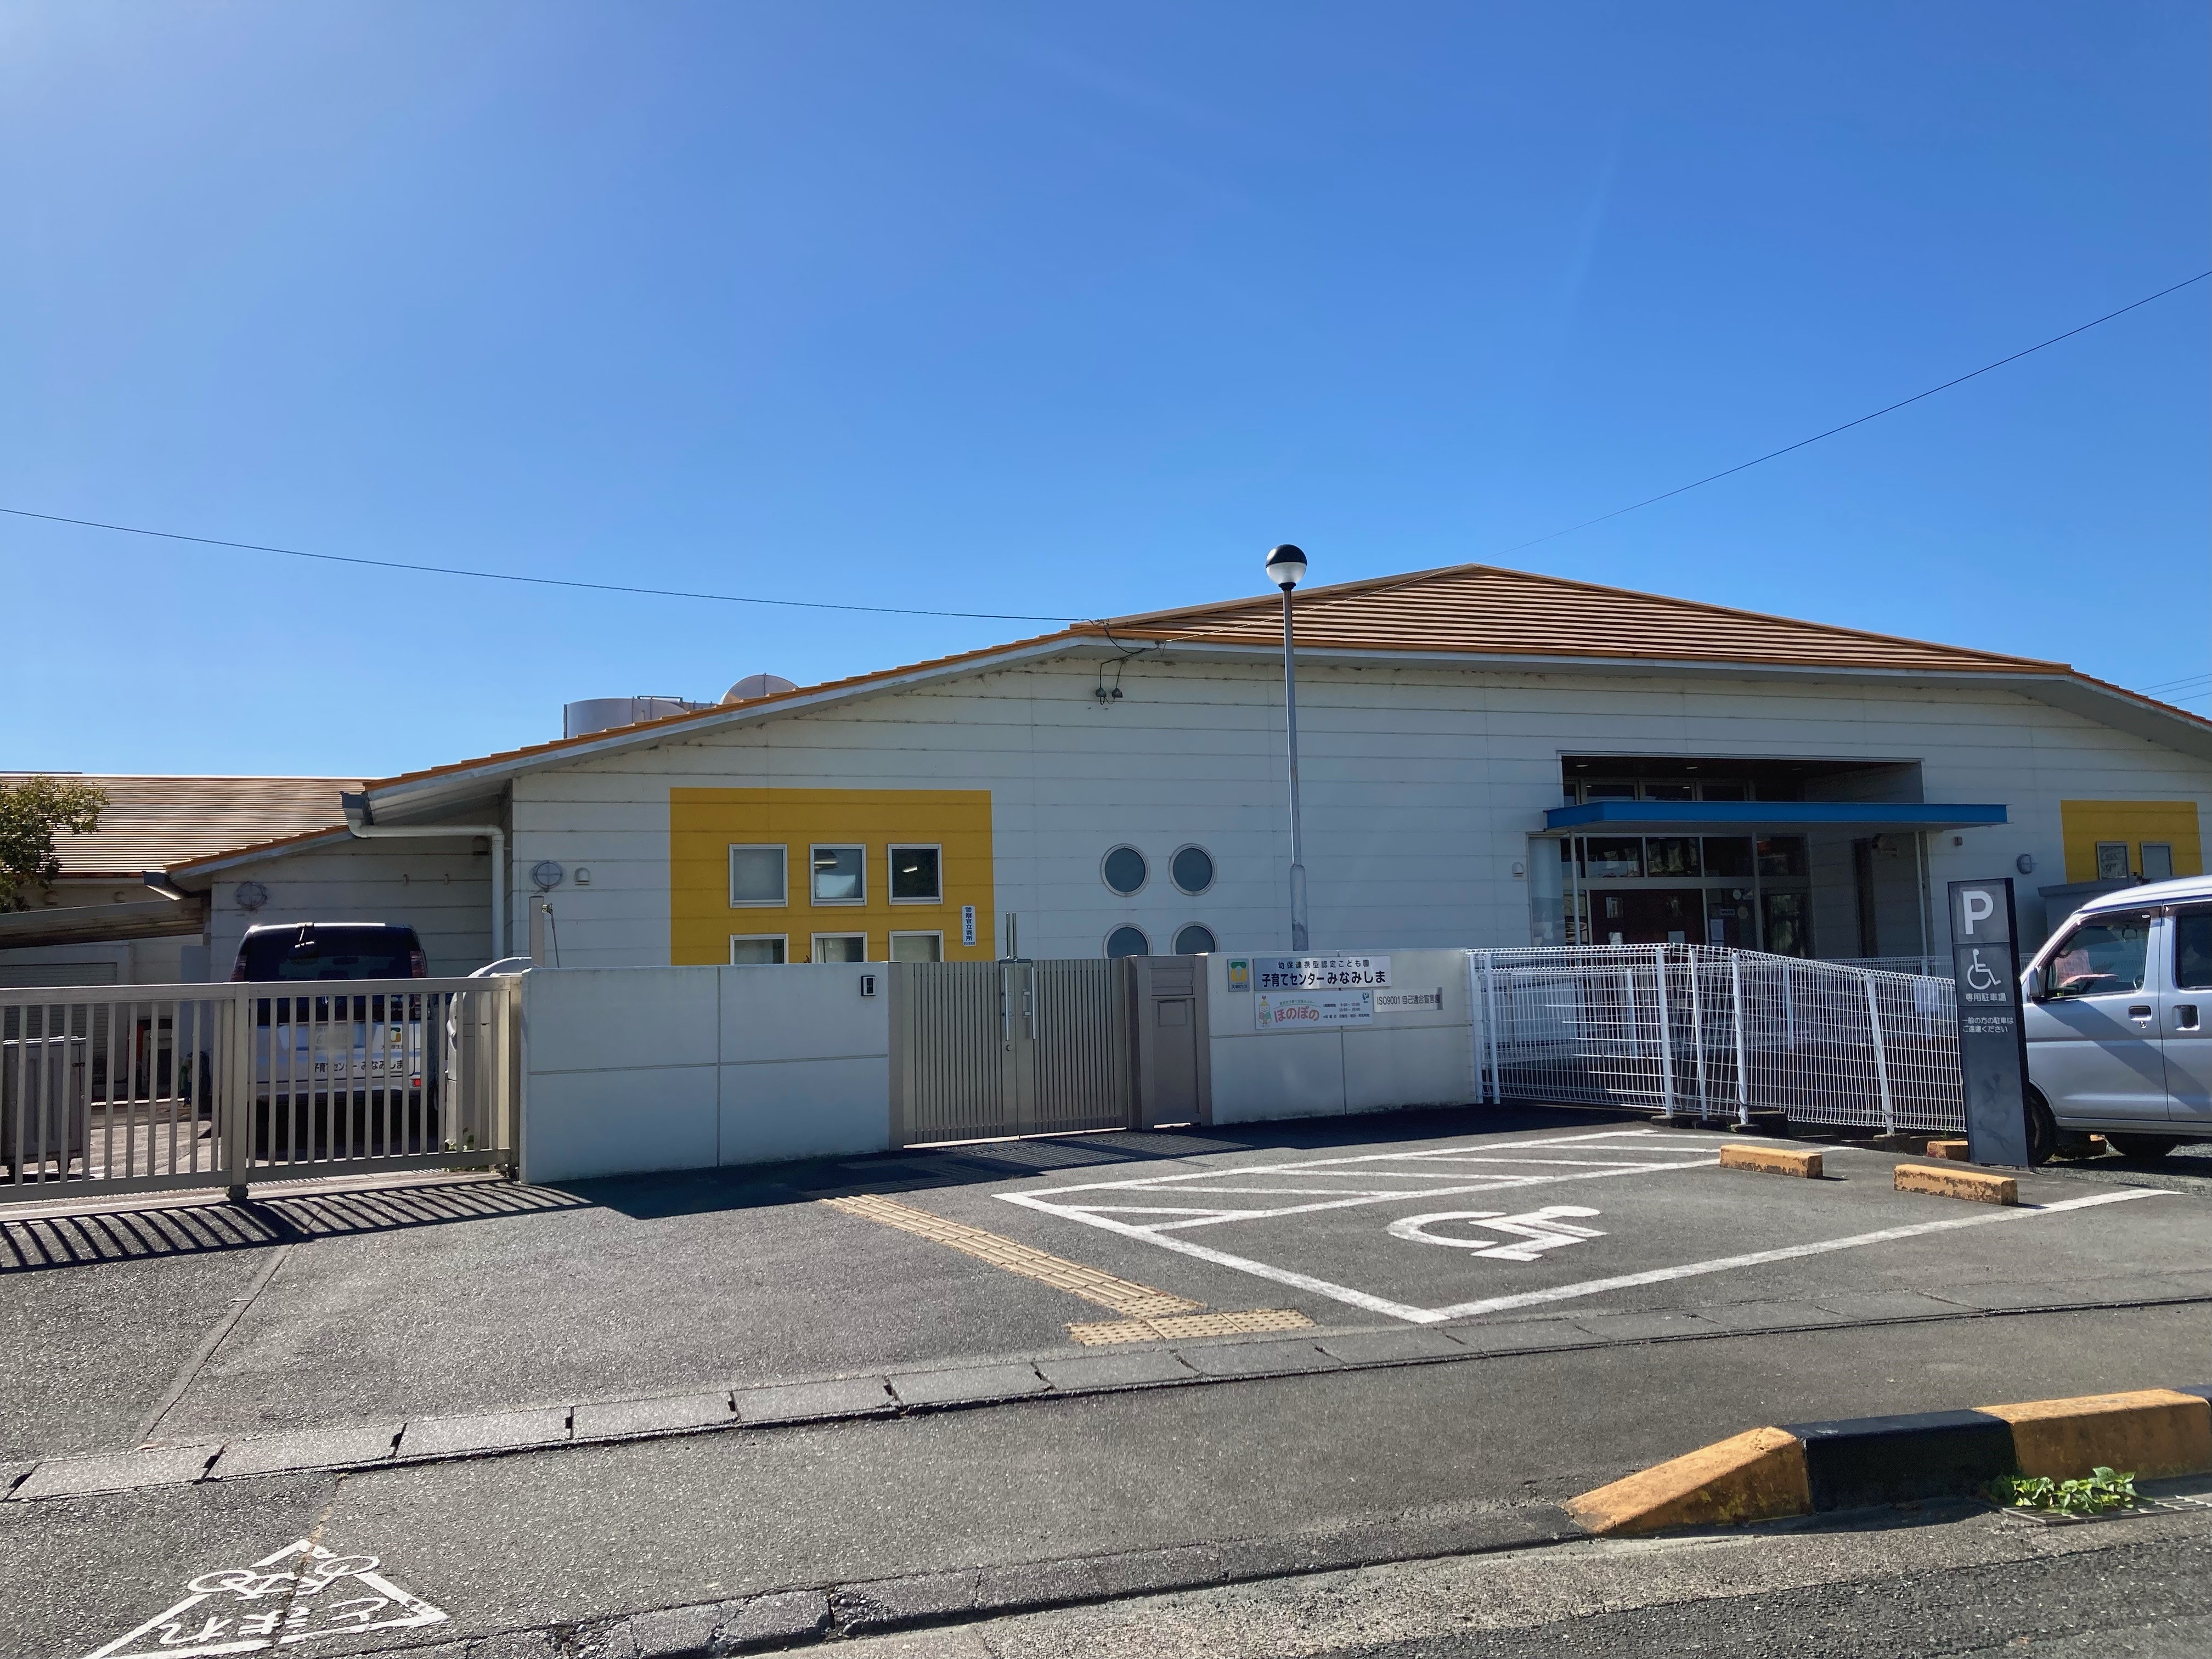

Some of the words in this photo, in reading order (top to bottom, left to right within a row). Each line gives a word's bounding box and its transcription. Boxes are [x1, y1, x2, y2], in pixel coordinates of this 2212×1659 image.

[1962, 890, 1994, 935] P
[1262, 970, 1386, 988] 子育てセンターみなみしま
[1376, 996, 1401, 1005] ISO9001
[1966, 992, 2006, 1002] 専用駐車場
[1274, 1006, 1319, 1024] ほのぼの
[159, 1595, 390, 1645] とまれ
